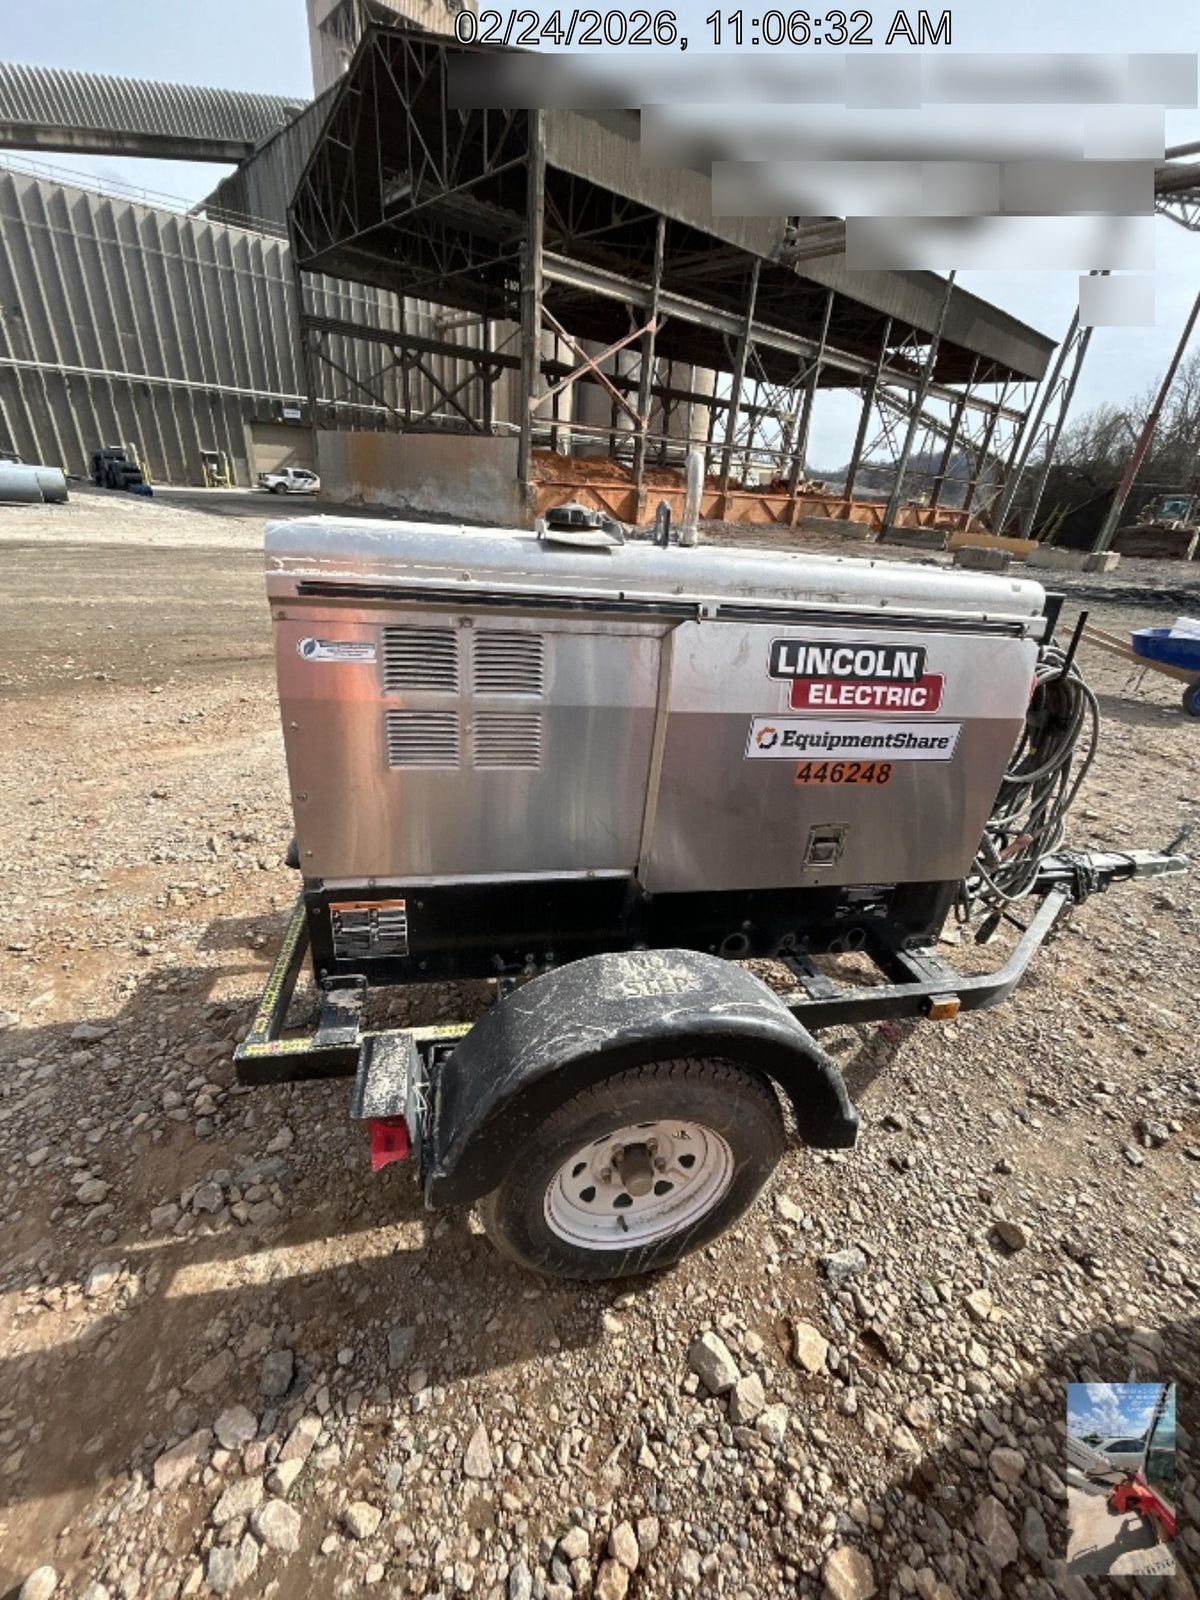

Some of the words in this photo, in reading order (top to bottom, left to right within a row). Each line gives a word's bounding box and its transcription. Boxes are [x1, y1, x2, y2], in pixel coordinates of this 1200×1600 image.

[777, 645, 918, 678] LINCOLN
[808, 683, 927, 707] ELECTRIC
[780, 730, 949, 750] EquipmentShare
[797, 762, 891, 783] 446248
